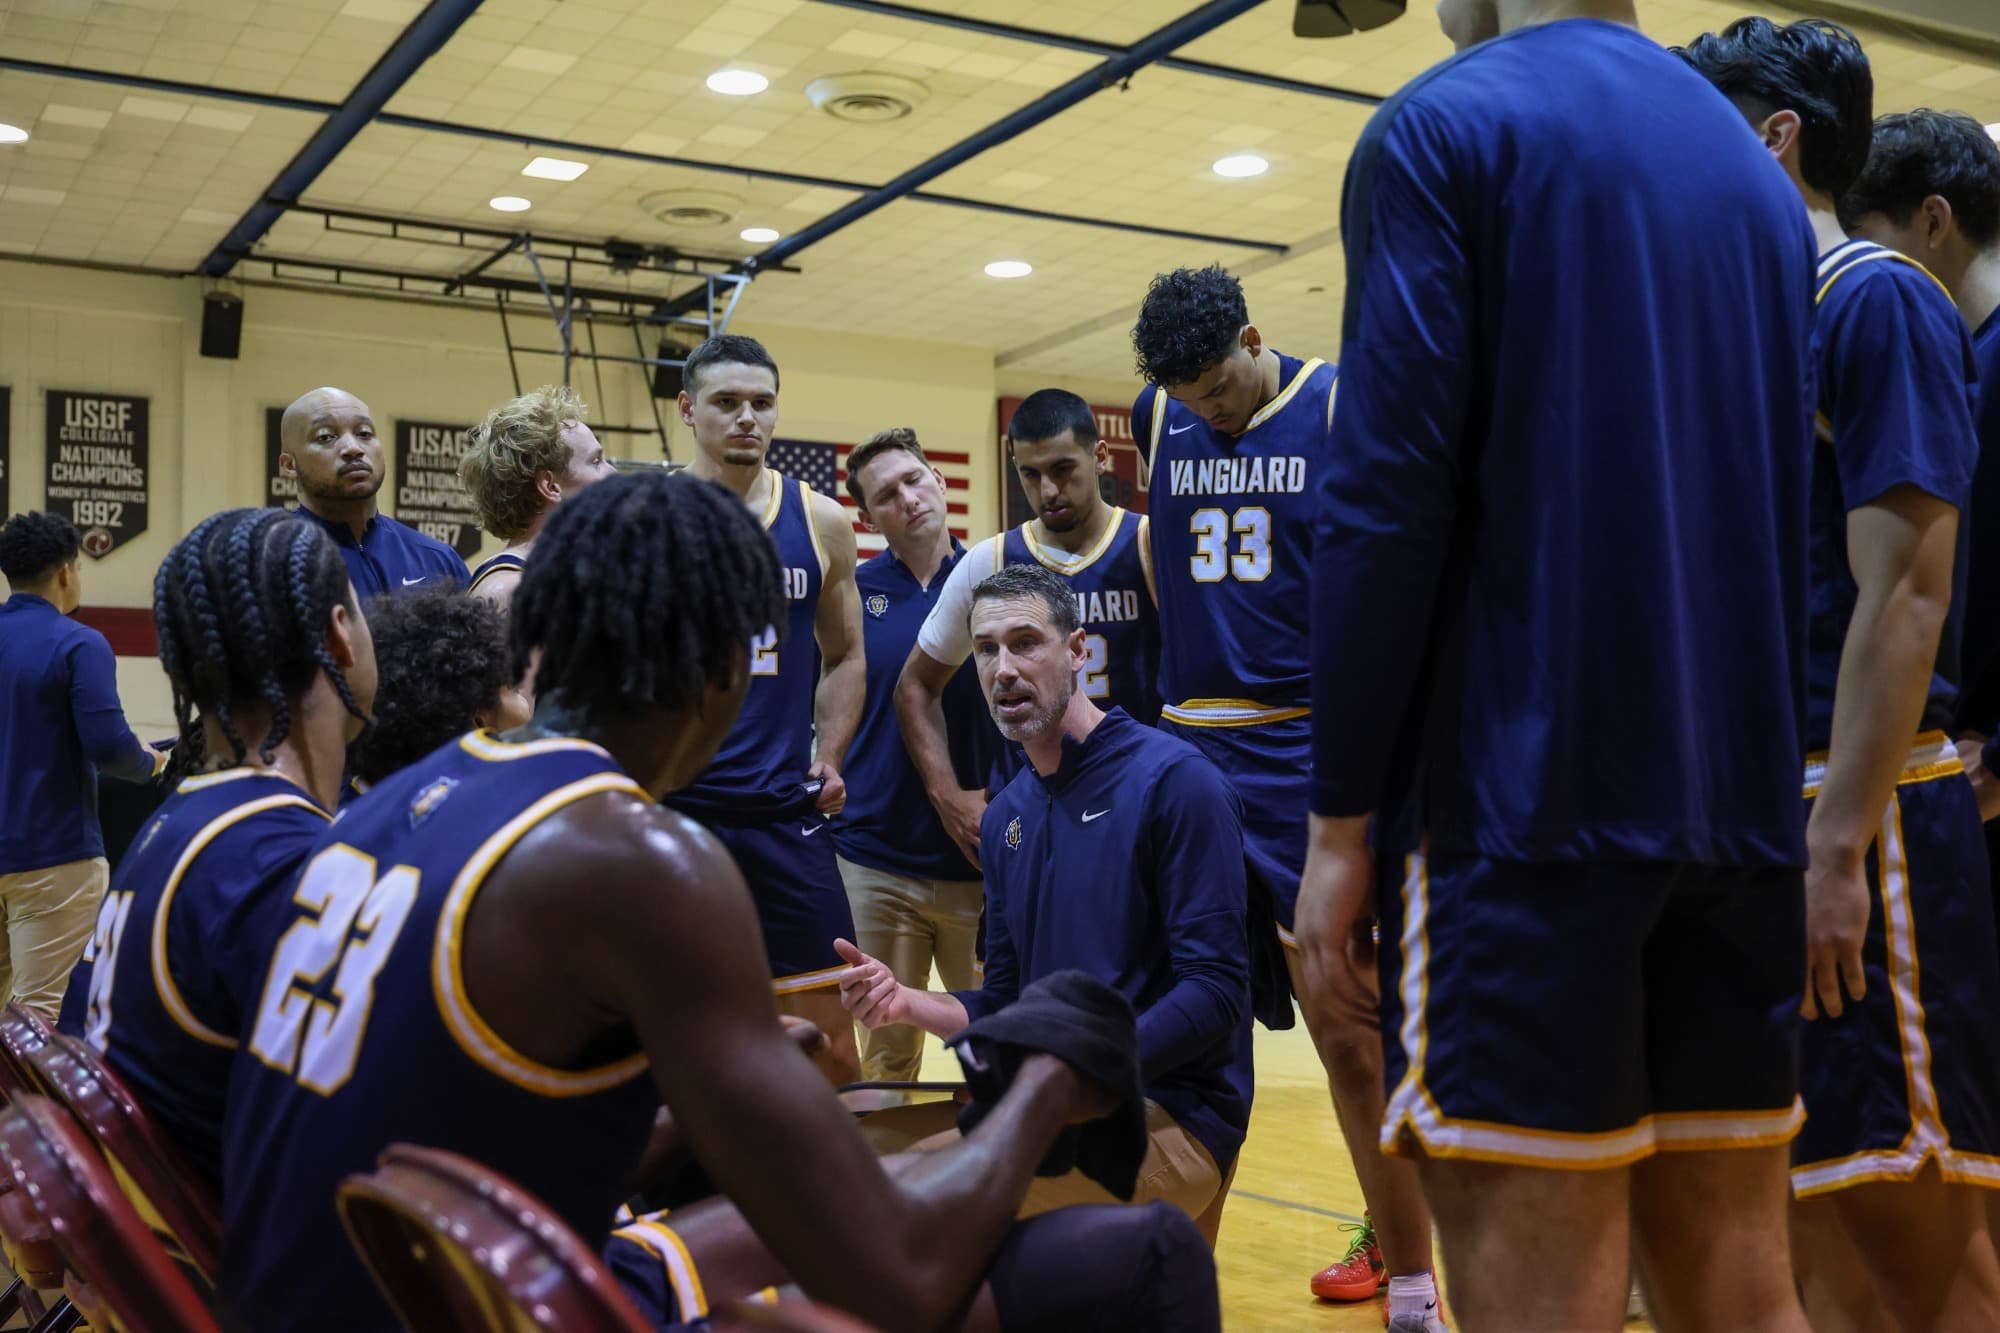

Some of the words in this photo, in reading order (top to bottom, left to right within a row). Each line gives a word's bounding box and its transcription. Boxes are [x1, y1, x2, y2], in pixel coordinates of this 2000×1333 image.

[65, 398, 132, 430] USGF
[59, 426, 135, 445] COLLEGIATE
[60, 445, 136, 467] NATIONAL
[52, 463, 144, 487] CHAMPIONS
[1169, 456, 1307, 496] VANGUARD
[72, 500, 123, 527] 1992
[399, 487, 473, 511] CHAMPION
[1189, 506, 1272, 583] 33
[1072, 589, 1139, 624] UARD
[749, 623, 779, 676] 2
[1076, 633, 1111, 699] 2
[248, 841, 421, 1097] 23
